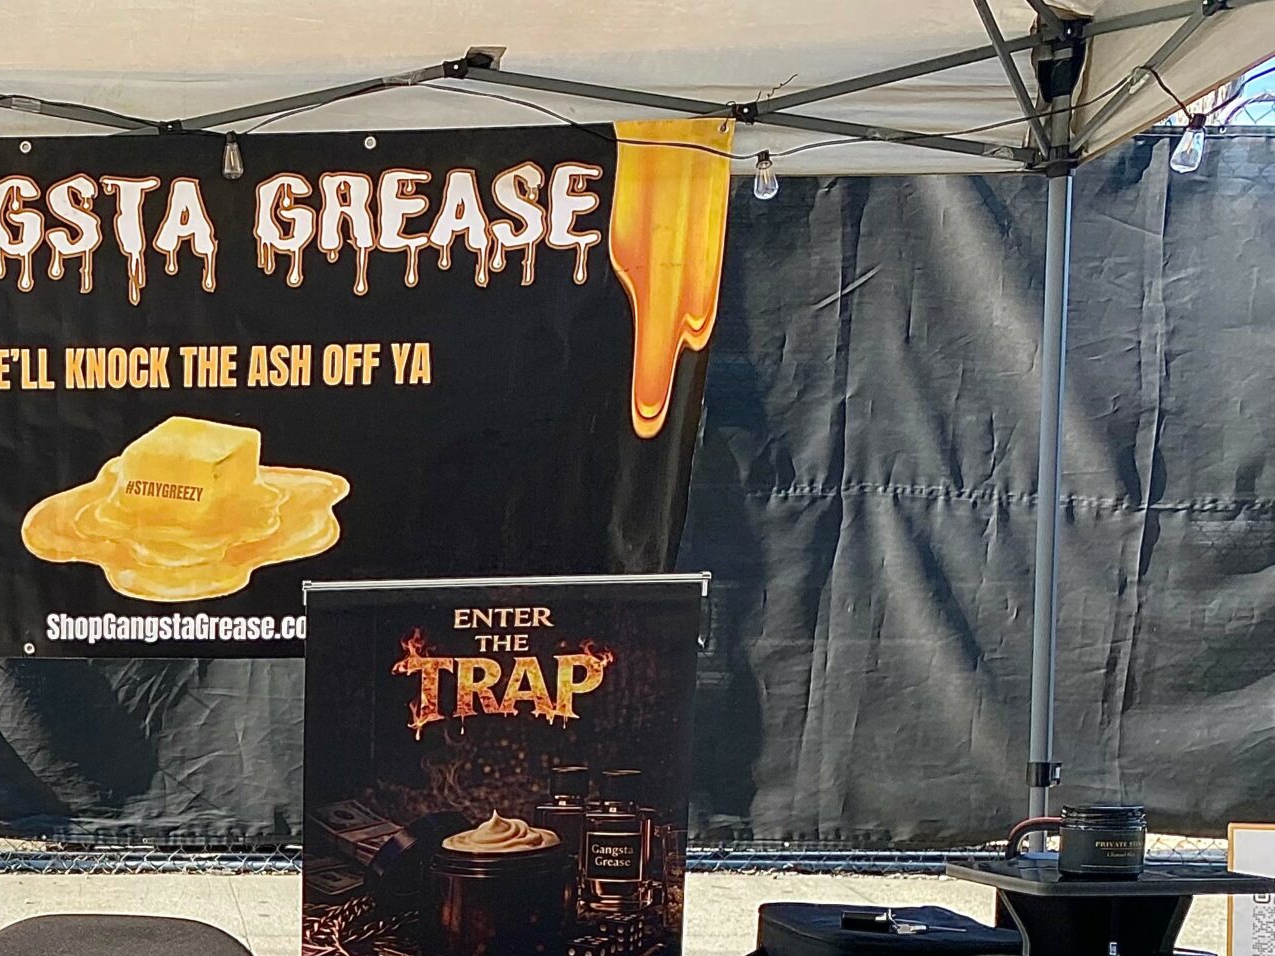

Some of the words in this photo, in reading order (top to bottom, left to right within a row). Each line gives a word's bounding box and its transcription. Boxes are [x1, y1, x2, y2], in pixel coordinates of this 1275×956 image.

[254, 162, 603, 295] GREASE
[65, 347, 170, 389] KNOCK
[179, 346, 237, 388] THE
[247, 344, 312, 387] ASH
[322, 343, 381, 386] OFF
[391, 342, 431, 385] YA
[125, 480, 204, 502] #STAYGREEZY
[46, 612, 307, 644] ShopGangstaGrease.co
[453, 607, 554, 630] ENTER
[474, 634, 529, 653] THE
[393, 652, 605, 729] TRAP
[591, 843, 634, 857] Gangsta
[594, 856, 631, 867] Grease
